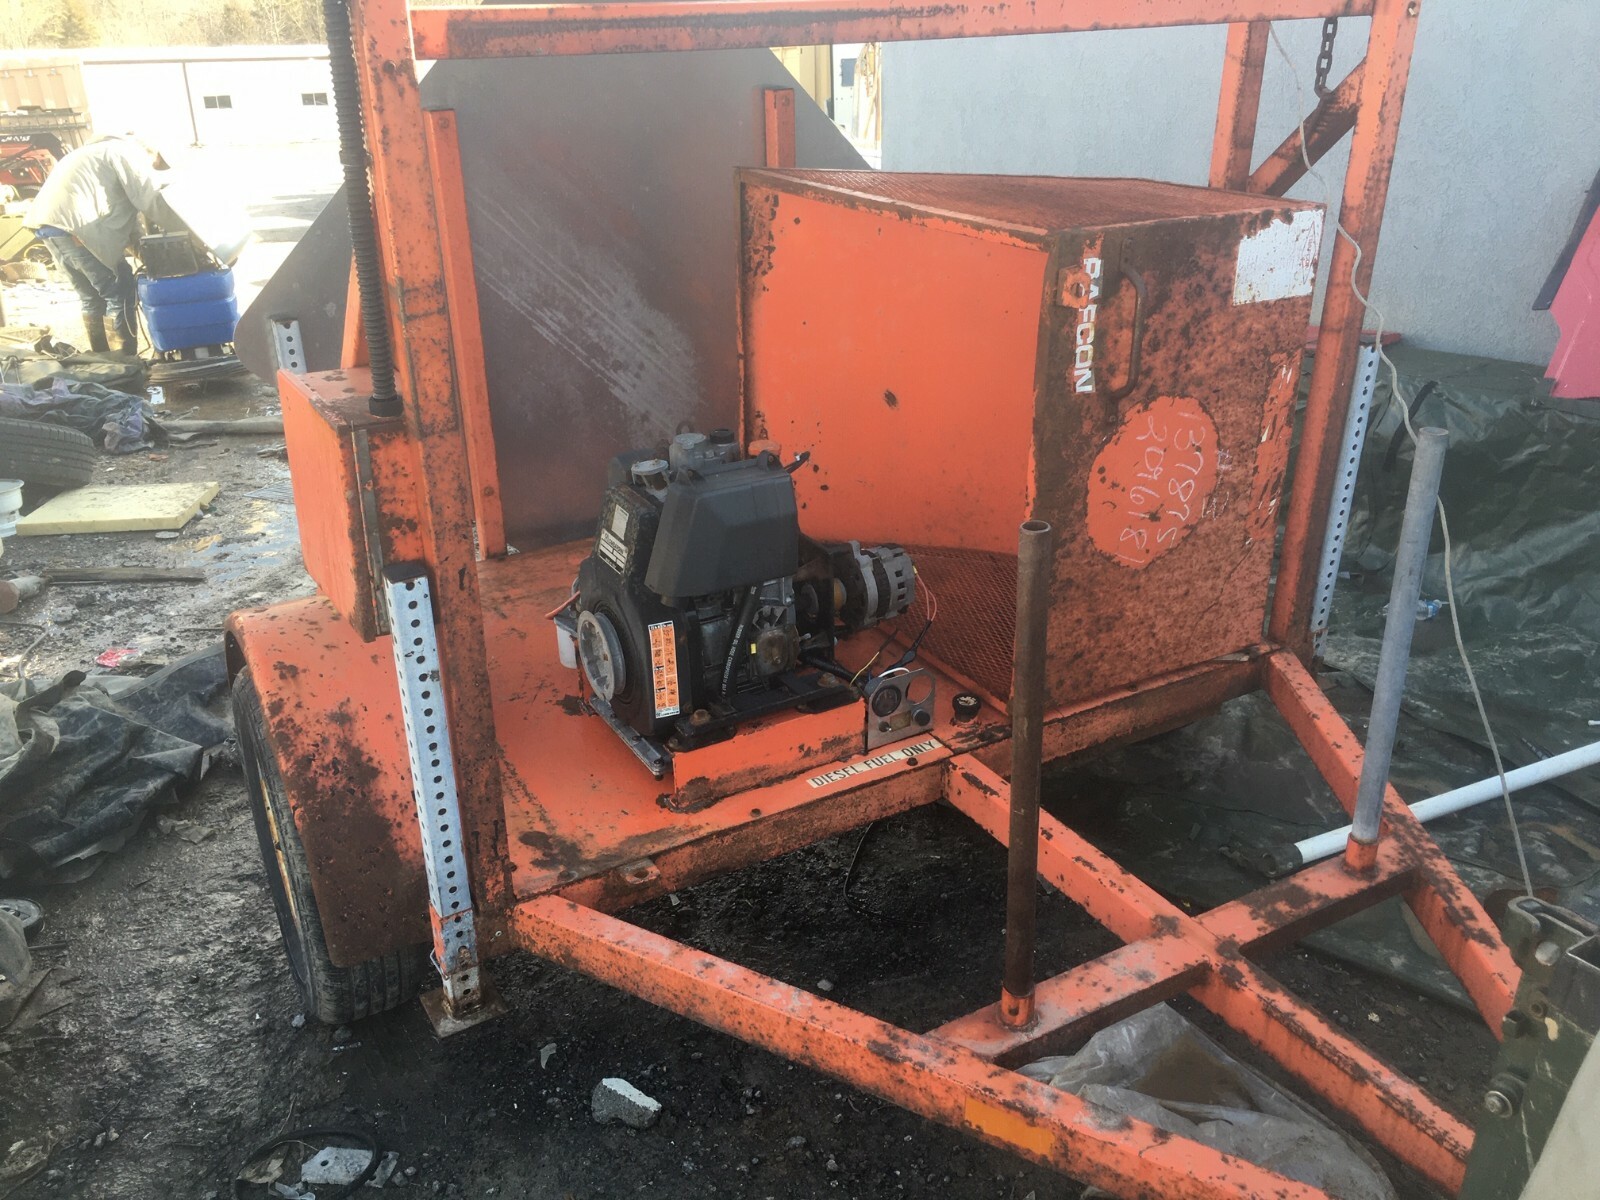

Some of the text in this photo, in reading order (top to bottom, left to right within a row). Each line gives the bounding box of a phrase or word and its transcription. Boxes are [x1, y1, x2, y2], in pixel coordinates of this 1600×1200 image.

[810, 740, 936, 787] DIESEL FUEL ONLY
